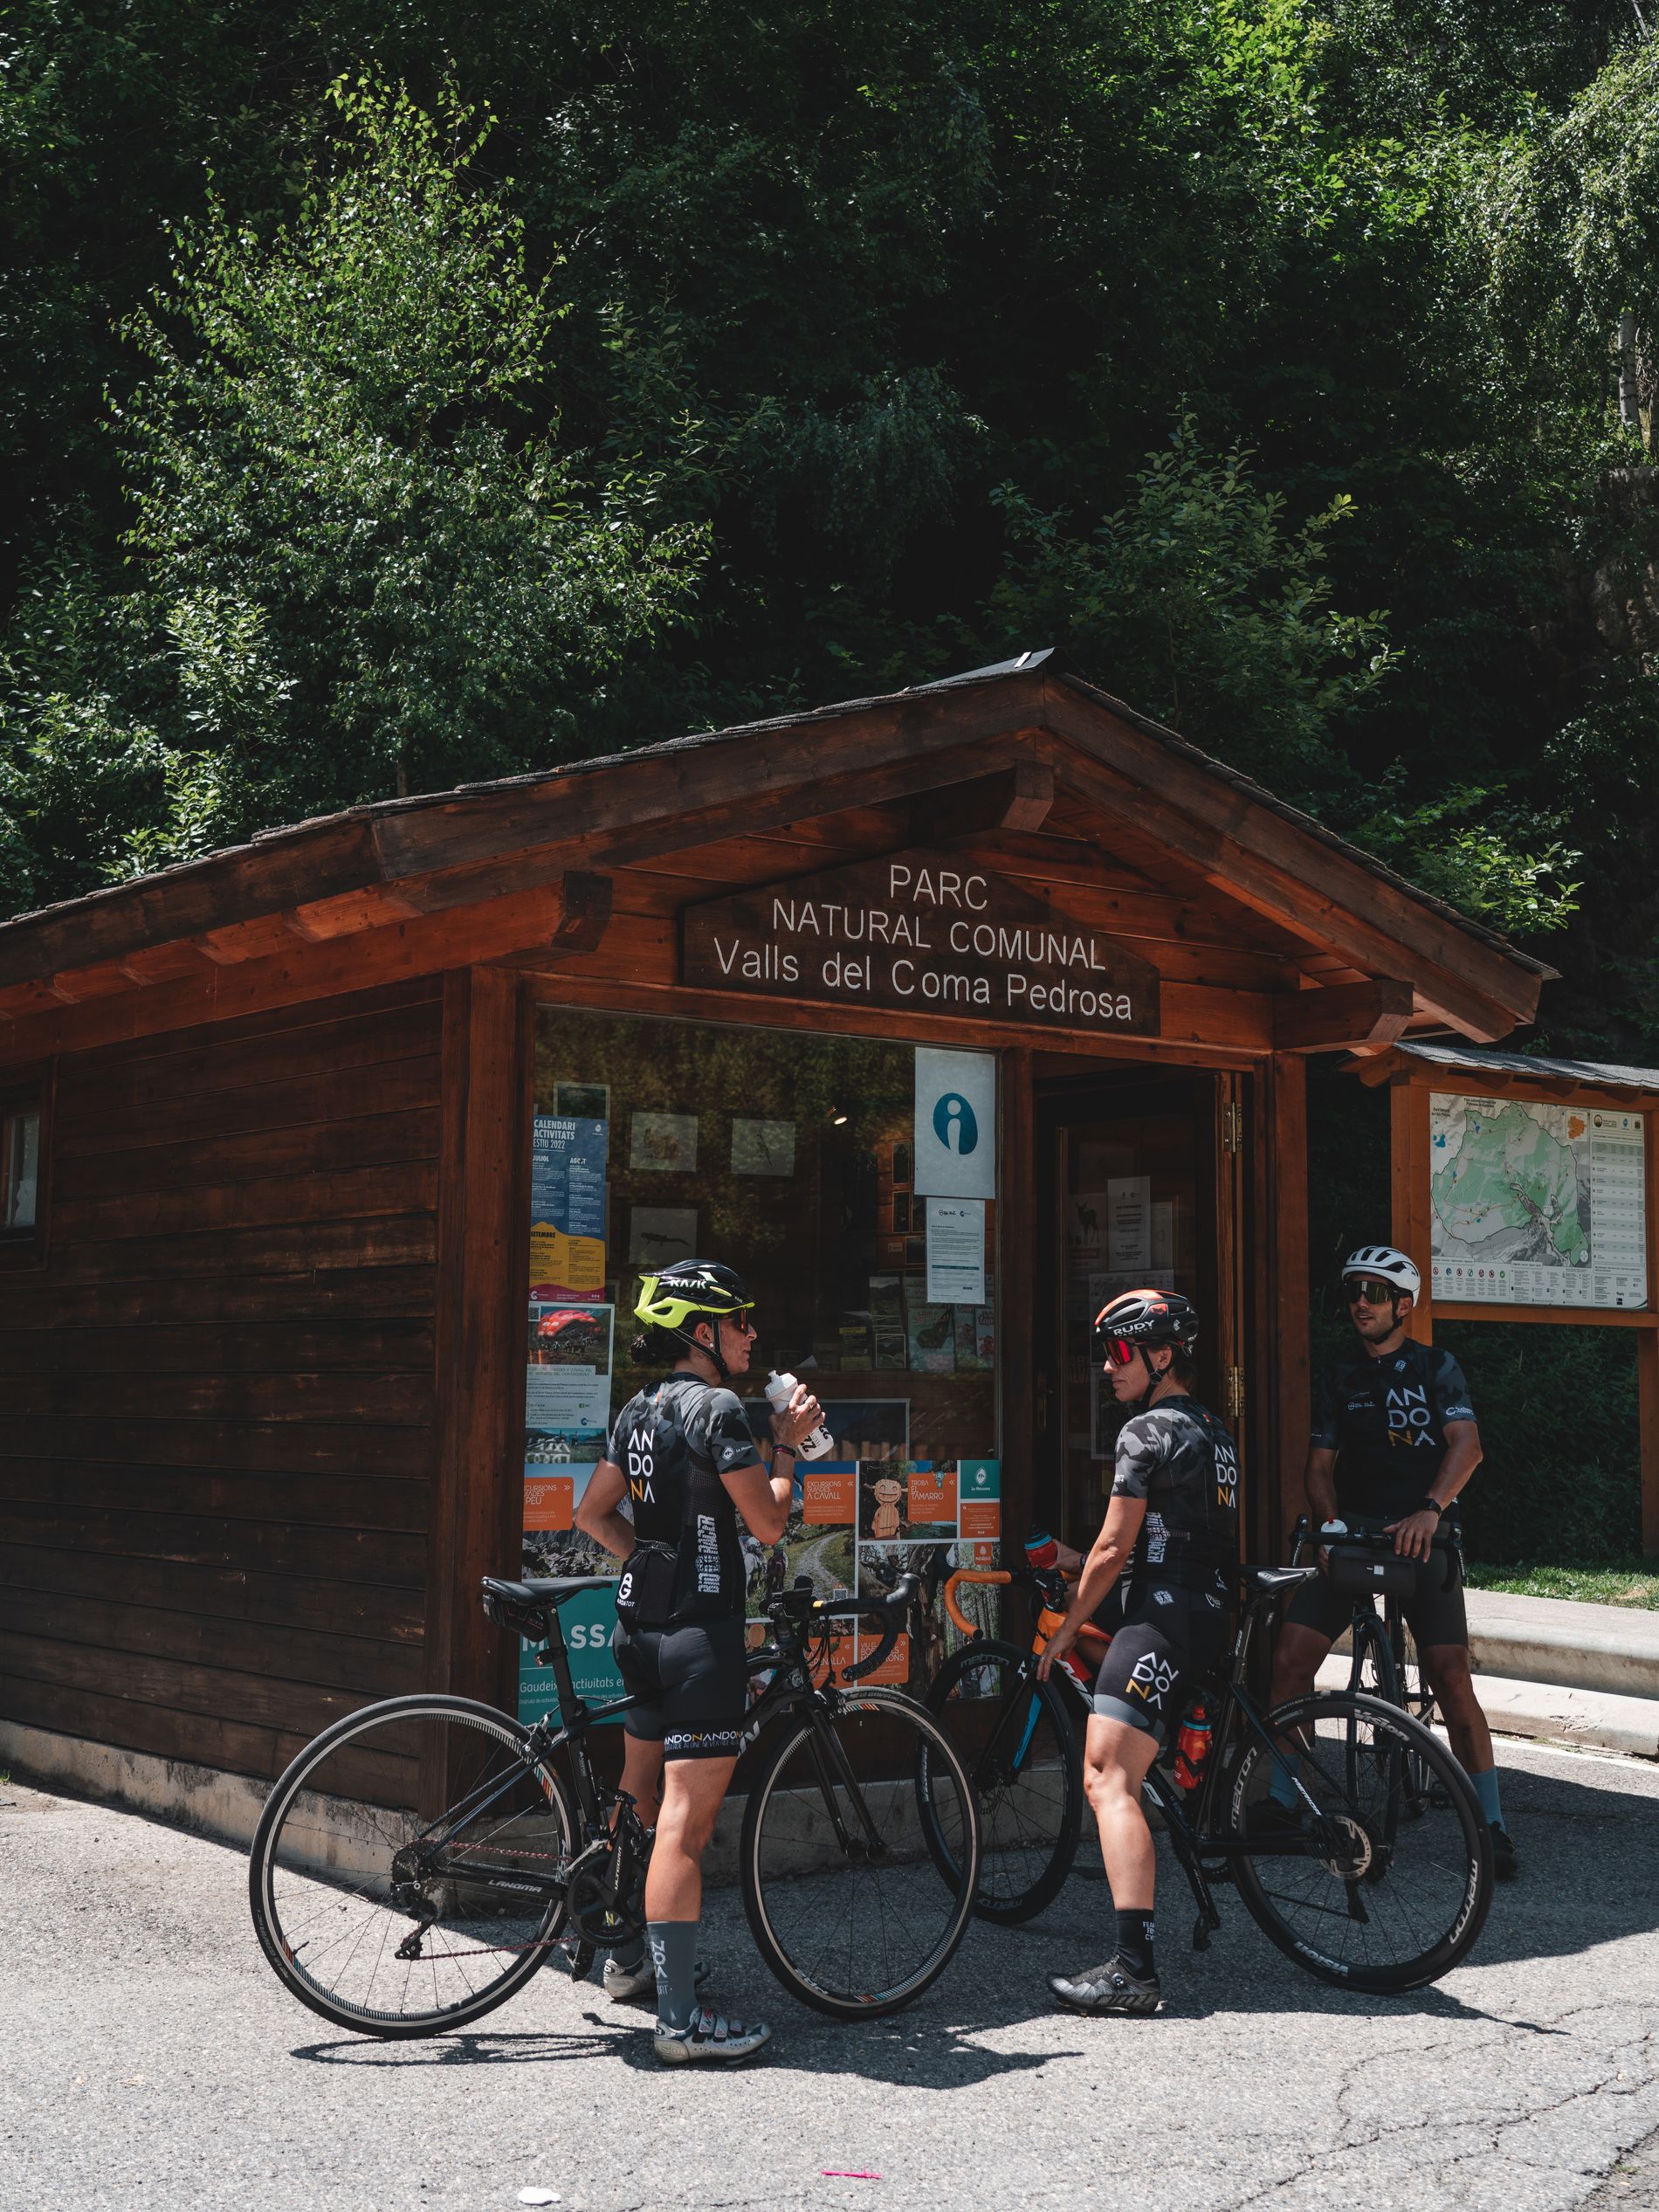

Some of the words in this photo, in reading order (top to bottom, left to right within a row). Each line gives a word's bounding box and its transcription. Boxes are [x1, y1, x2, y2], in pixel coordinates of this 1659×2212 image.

[890, 865, 988, 910] PARC
[772, 898, 932, 948] NATURAL
[949, 920, 1106, 970] COMUNAL
[713, 936, 800, 982] Valls
[822, 952, 871, 990] del
[891, 959, 991, 1005] Coma
[1006, 973, 1132, 1021] Pedrosa
[533, 1119, 576, 1131] CALENDARI
[533, 1129, 575, 1140] ACTIVITATS
[533, 1138, 549, 1148] ESTIU
[550, 1140, 566, 1149] 2022
[670, 1278, 707, 1290] KASK
[1112, 1320, 1155, 1336] RUDY
[526, 1496, 542, 1505] PEU
[814, 1492, 843, 1500] CAVALL
[911, 1492, 944, 1501] TAMARRO
[522, 1623, 615, 1651] MSS
[1231, 1746, 1257, 1830] metron
[487, 1878, 543, 1893] LANGMA
[1449, 1858, 1479, 1944] metron
